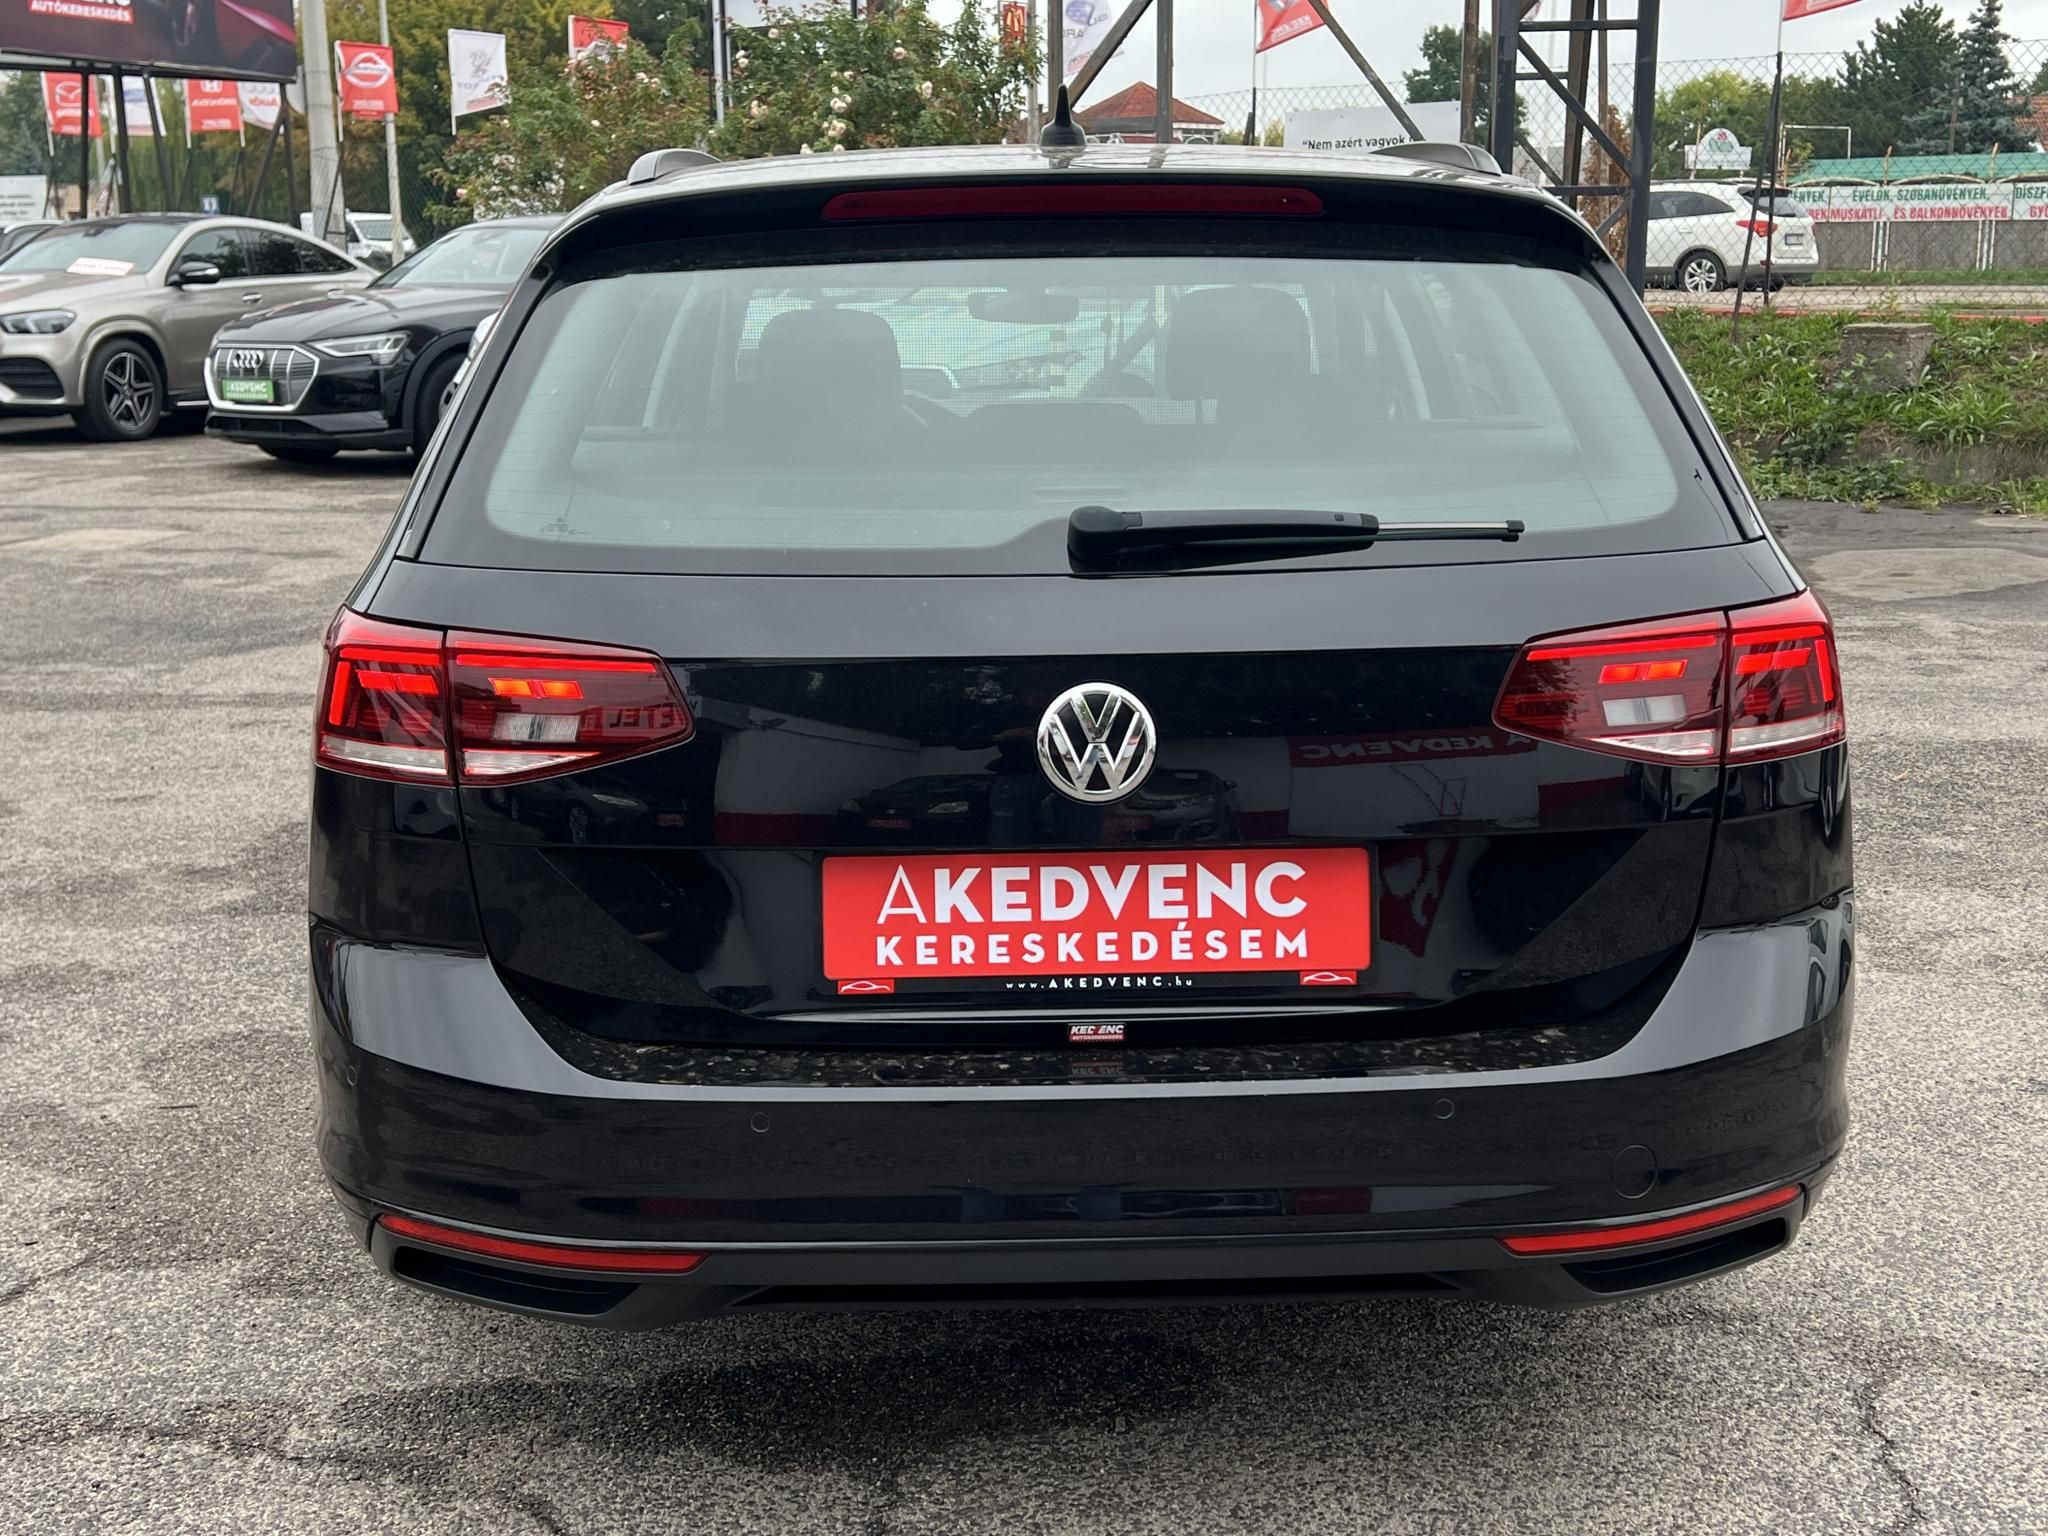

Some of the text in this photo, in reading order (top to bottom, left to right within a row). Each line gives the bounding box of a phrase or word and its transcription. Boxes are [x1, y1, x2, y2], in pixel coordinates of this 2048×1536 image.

[1335, 138, 1362, 148] azért
[1365, 133, 1405, 148] vagyok
[876, 922, 1307, 966] KERESKEDÉSEM
[1006, 975, 1192, 989] www.AKEDVENC.hu
